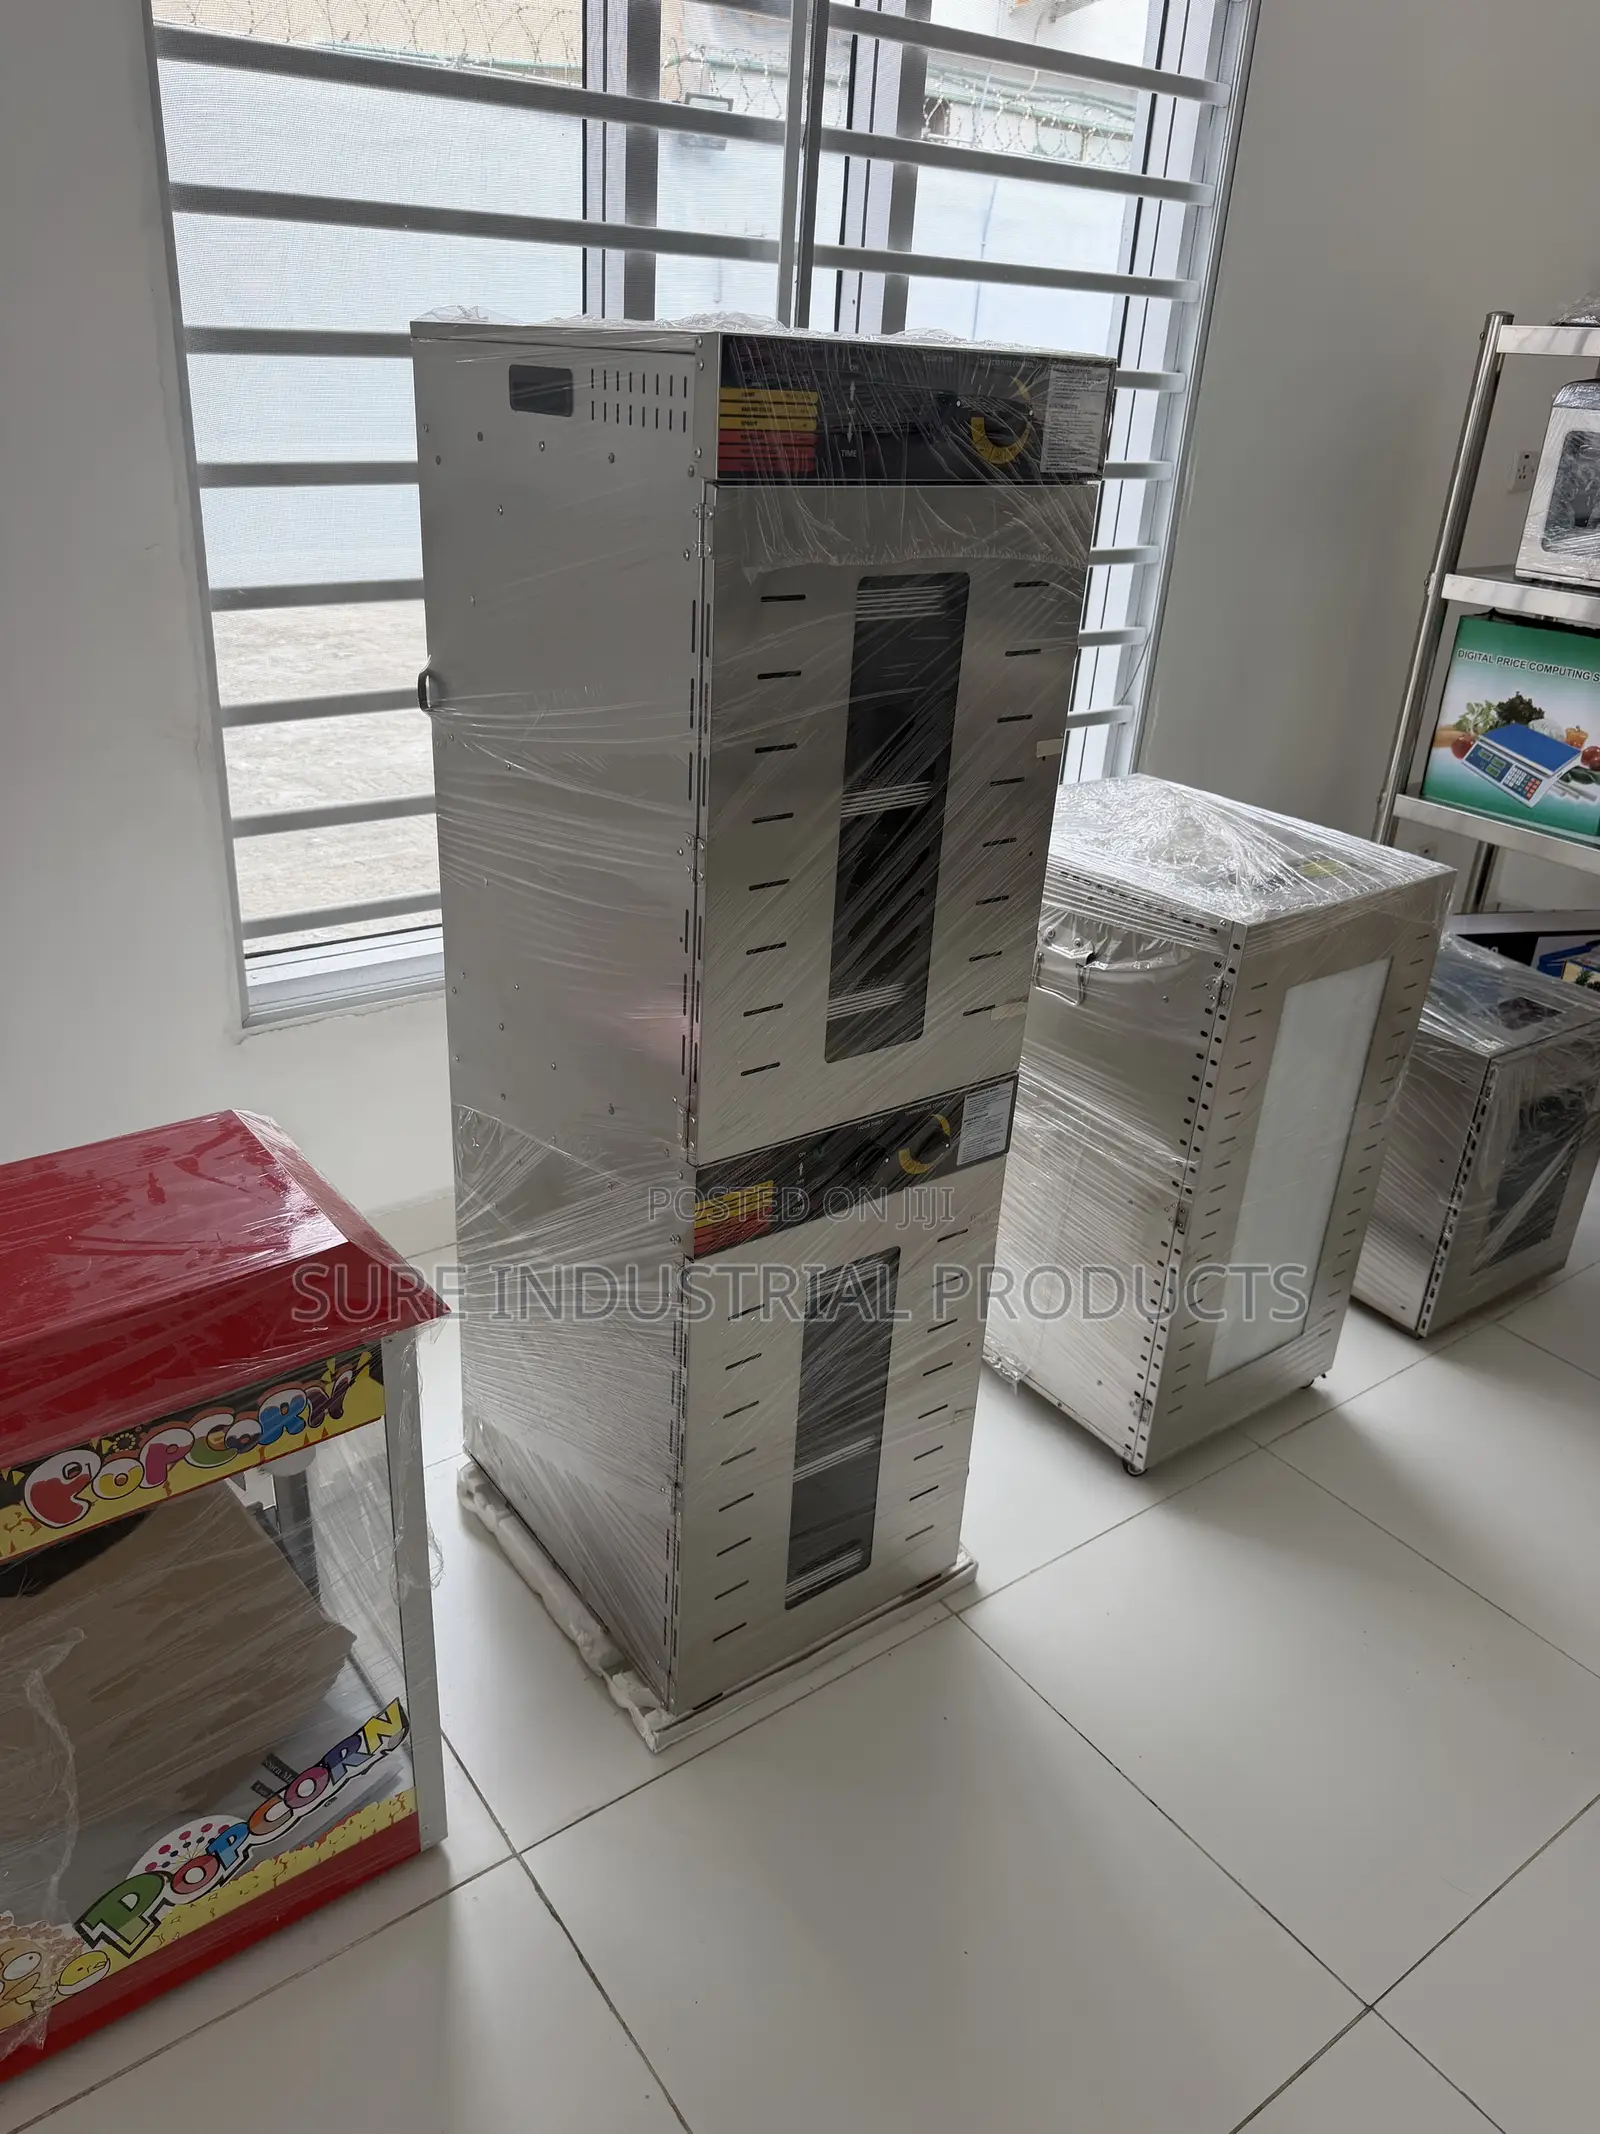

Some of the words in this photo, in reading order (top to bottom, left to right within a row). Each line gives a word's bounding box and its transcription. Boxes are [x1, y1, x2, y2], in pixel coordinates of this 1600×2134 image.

[841, 449, 858, 459] TIME
[1457, 649, 1494, 664] DIGITAL
[1497, 656, 1527, 670] PRICE
[1529, 661, 1590, 681] COMPUTING
